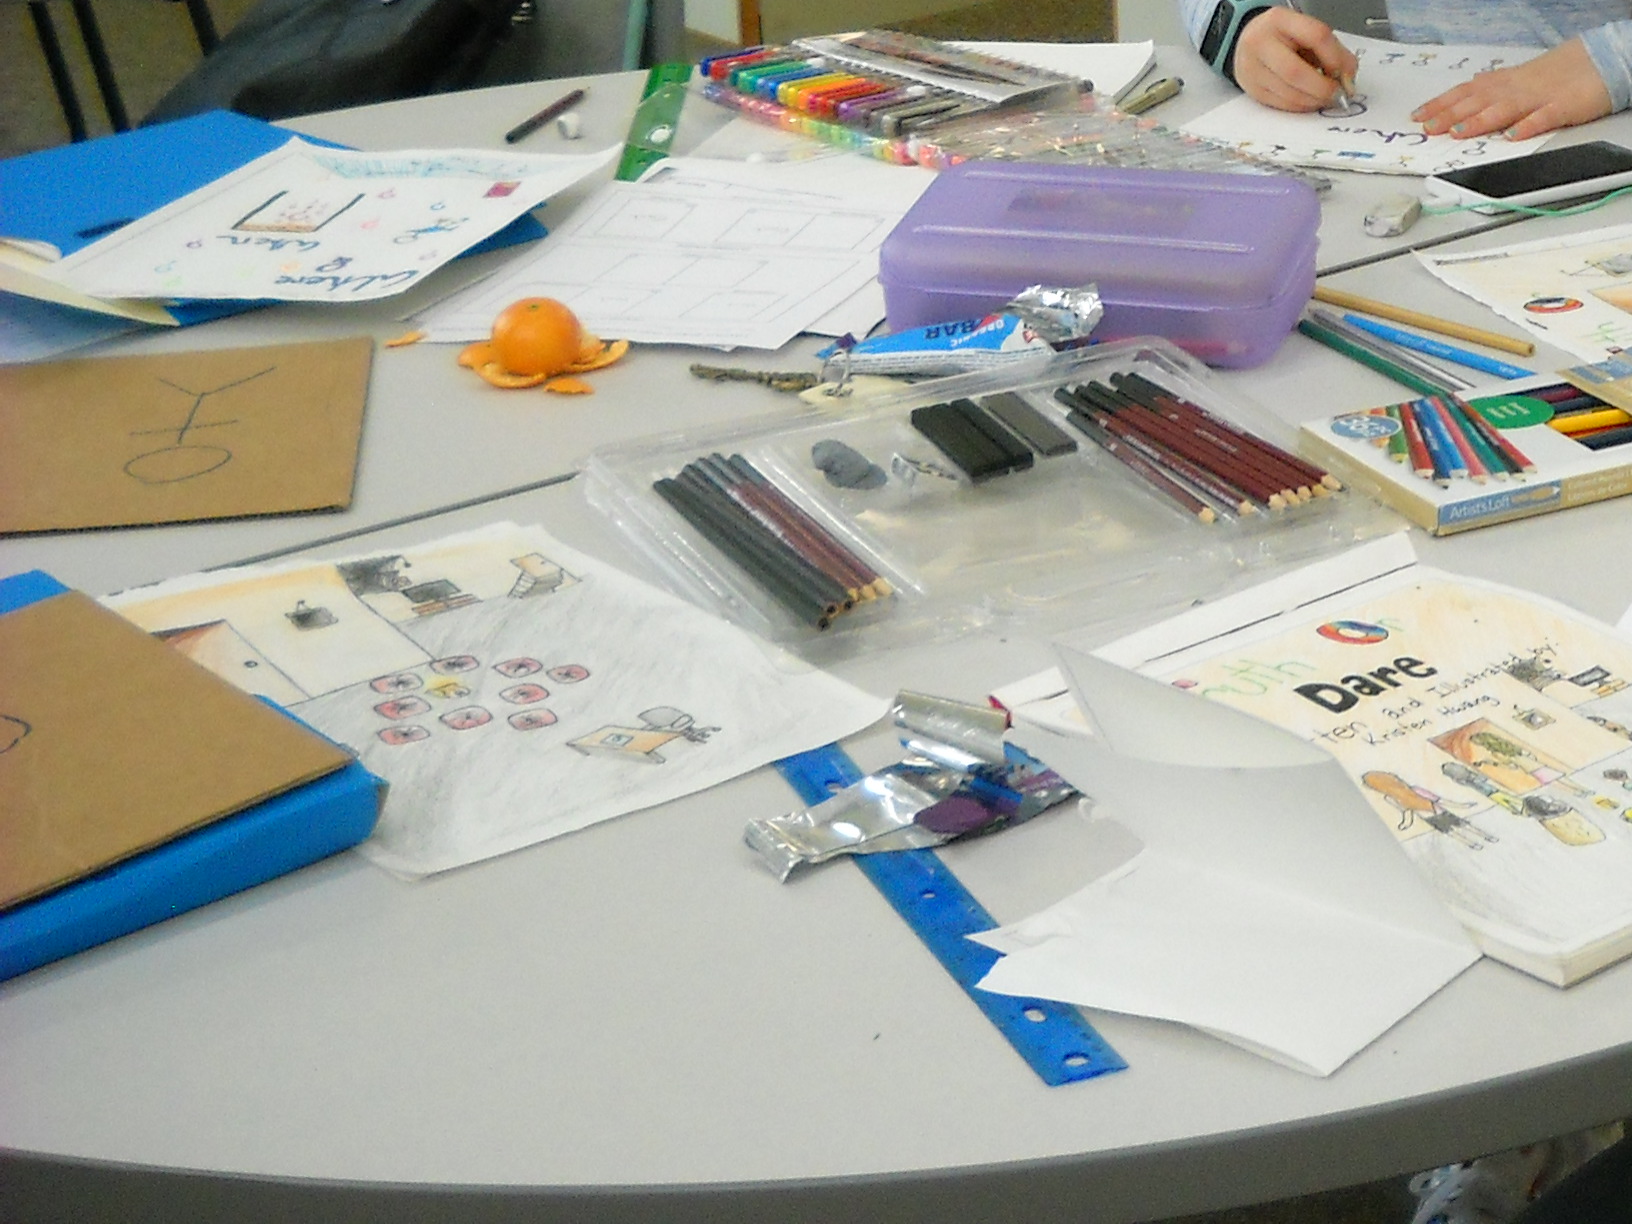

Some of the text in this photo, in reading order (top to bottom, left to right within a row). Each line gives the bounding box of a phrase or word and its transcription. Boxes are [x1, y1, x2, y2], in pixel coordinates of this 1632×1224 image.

[1293, 656, 1438, 714] Dare
[1383, 697, 1424, 719] and
[1426, 653, 1521, 698] Illustrated
[1364, 717, 1432, 747] Kristen
